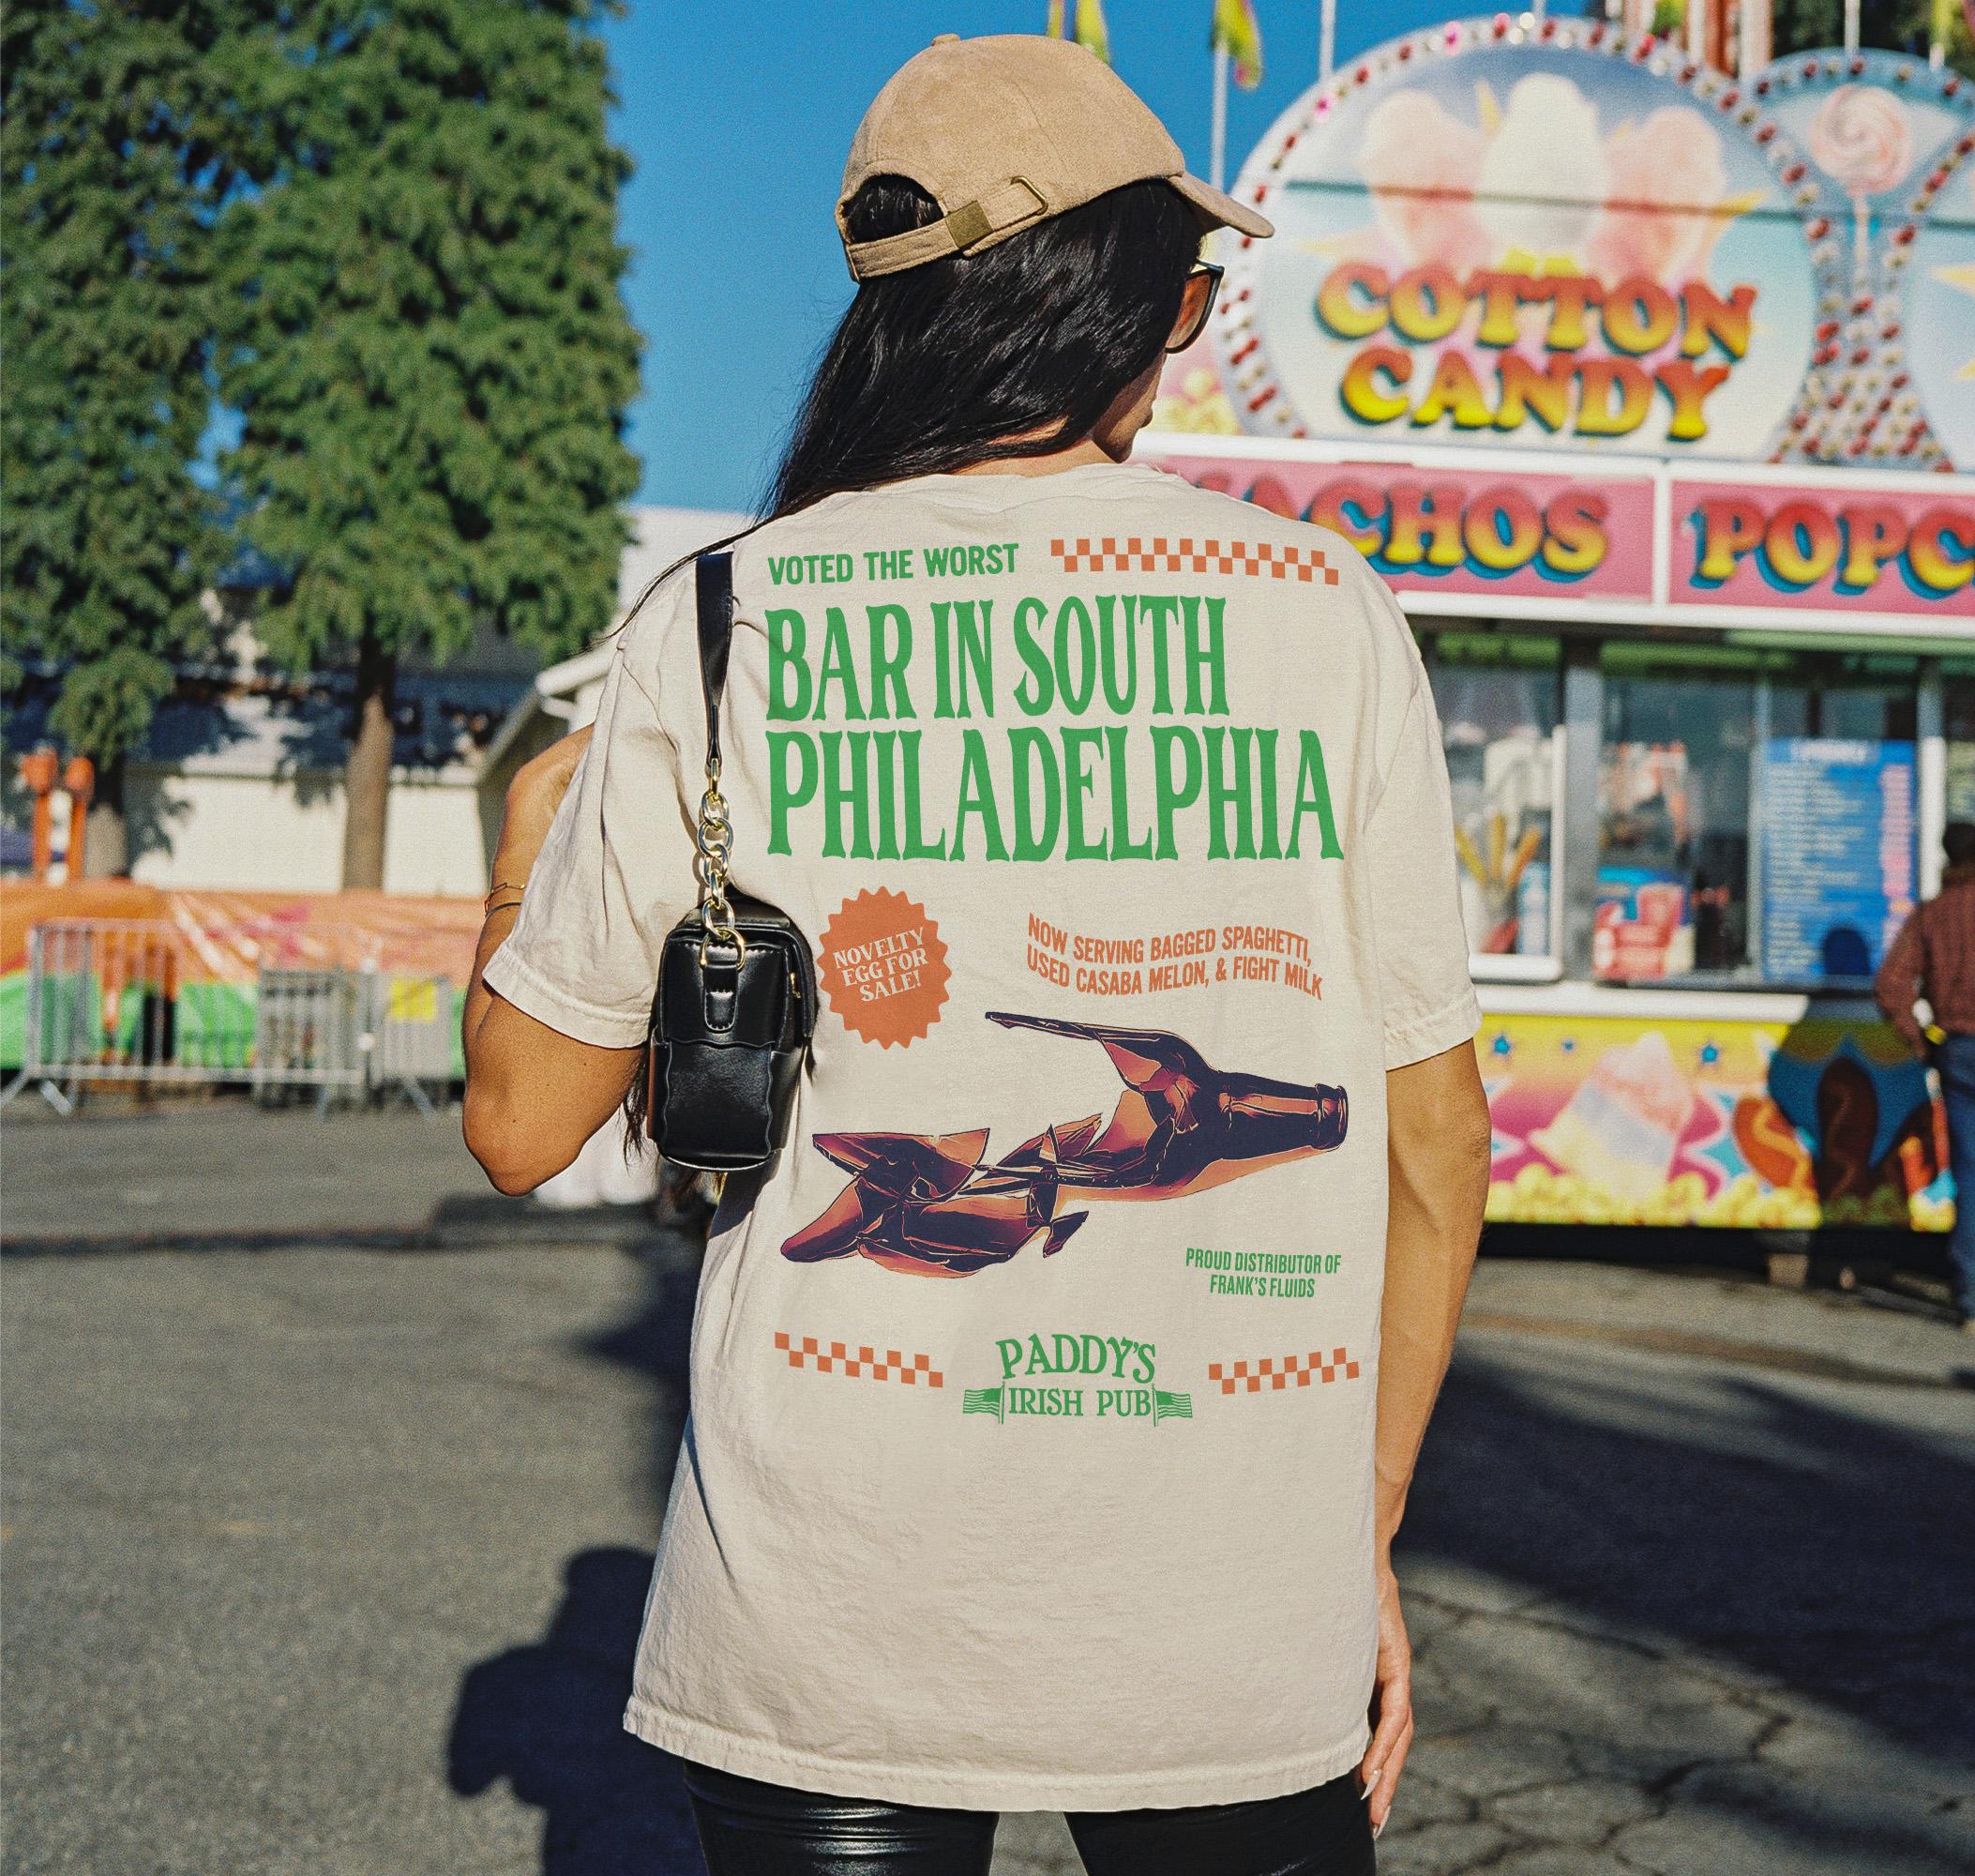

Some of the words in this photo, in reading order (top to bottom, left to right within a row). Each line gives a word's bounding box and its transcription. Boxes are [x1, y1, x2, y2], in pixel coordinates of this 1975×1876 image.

[1313, 261, 1757, 361] COTTON
[1338, 345, 1731, 442] CANDY
[1193, 472, 1609, 583] CHOS
[768, 553, 853, 585] VOTED
[863, 549, 913, 582] THE
[923, 542, 1020, 578] WORST
[764, 604, 916, 721] BAR
[930, 600, 995, 719] IN
[1012, 594, 1230, 717] SOUTH
[765, 725, 1344, 863] PHILADELPHIA
[833, 927, 924, 969] NOVELTY
[1028, 913, 1068, 956] NOW
[1073, 935, 1144, 964] SERVING
[1151, 929, 1216, 961] BAGGED
[1221, 926, 1312, 967] SPAGHETTI,
[841, 961, 884, 987] EGG
[884, 948, 928, 976] FOR
[859, 970, 922, 1002] SALE!
[1027, 944, 1070, 988] USED
[1077, 967, 1142, 996] CASABA
[1149, 961, 1210, 992] MELON,
[1214, 957, 1228, 982] &
[1233, 956, 1280, 982] FIGHT
[1284, 961, 1323, 1001] MILK
[1185, 1248, 1231, 1270] PROUD
[1235, 1251, 1321, 1275] DISTRIBUTOR
[1324, 1253, 1340, 1275] OF
[1210, 1275, 1266, 1296] FRANK’S
[1269, 1278, 1316, 1298] FLUIDS
[995, 1334, 1155, 1384] PADDY’S
[1009, 1387, 1082, 1416] IRISH
[1096, 1388, 1151, 1417] PUB
